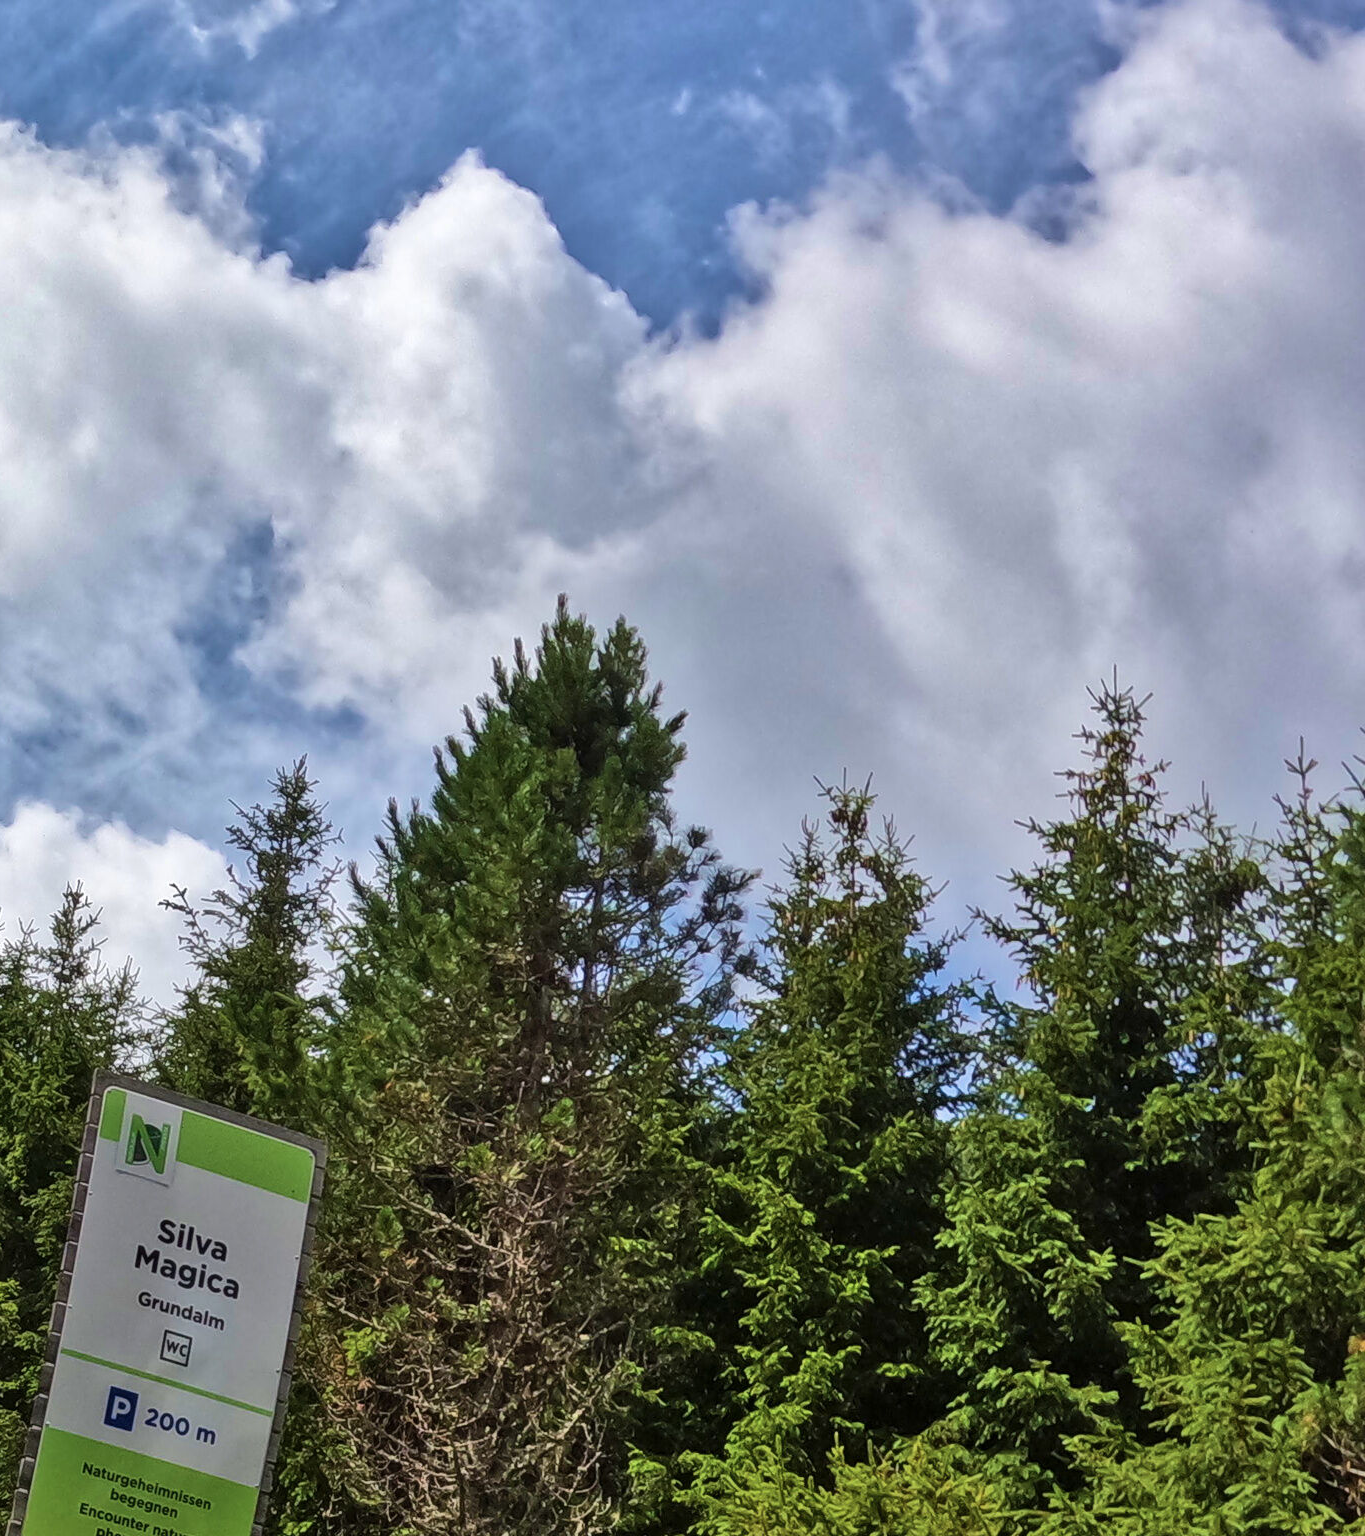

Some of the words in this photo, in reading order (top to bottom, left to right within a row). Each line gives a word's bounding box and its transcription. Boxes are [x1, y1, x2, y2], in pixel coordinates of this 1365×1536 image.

[157, 1219, 228, 1262] Silva
[134, 1245, 240, 1299] Magica
[138, 1291, 225, 1331] Grundalm
[166, 1339, 188, 1357] WC
[110, 1395, 131, 1420] P
[145, 1408, 190, 1435] 200
[196, 1427, 216, 1445] m
[82, 1462, 211, 1510] Naturgeheimnissen
[110, 1488, 178, 1518] begegnen
[79, 1503, 150, 1532] Encounter
